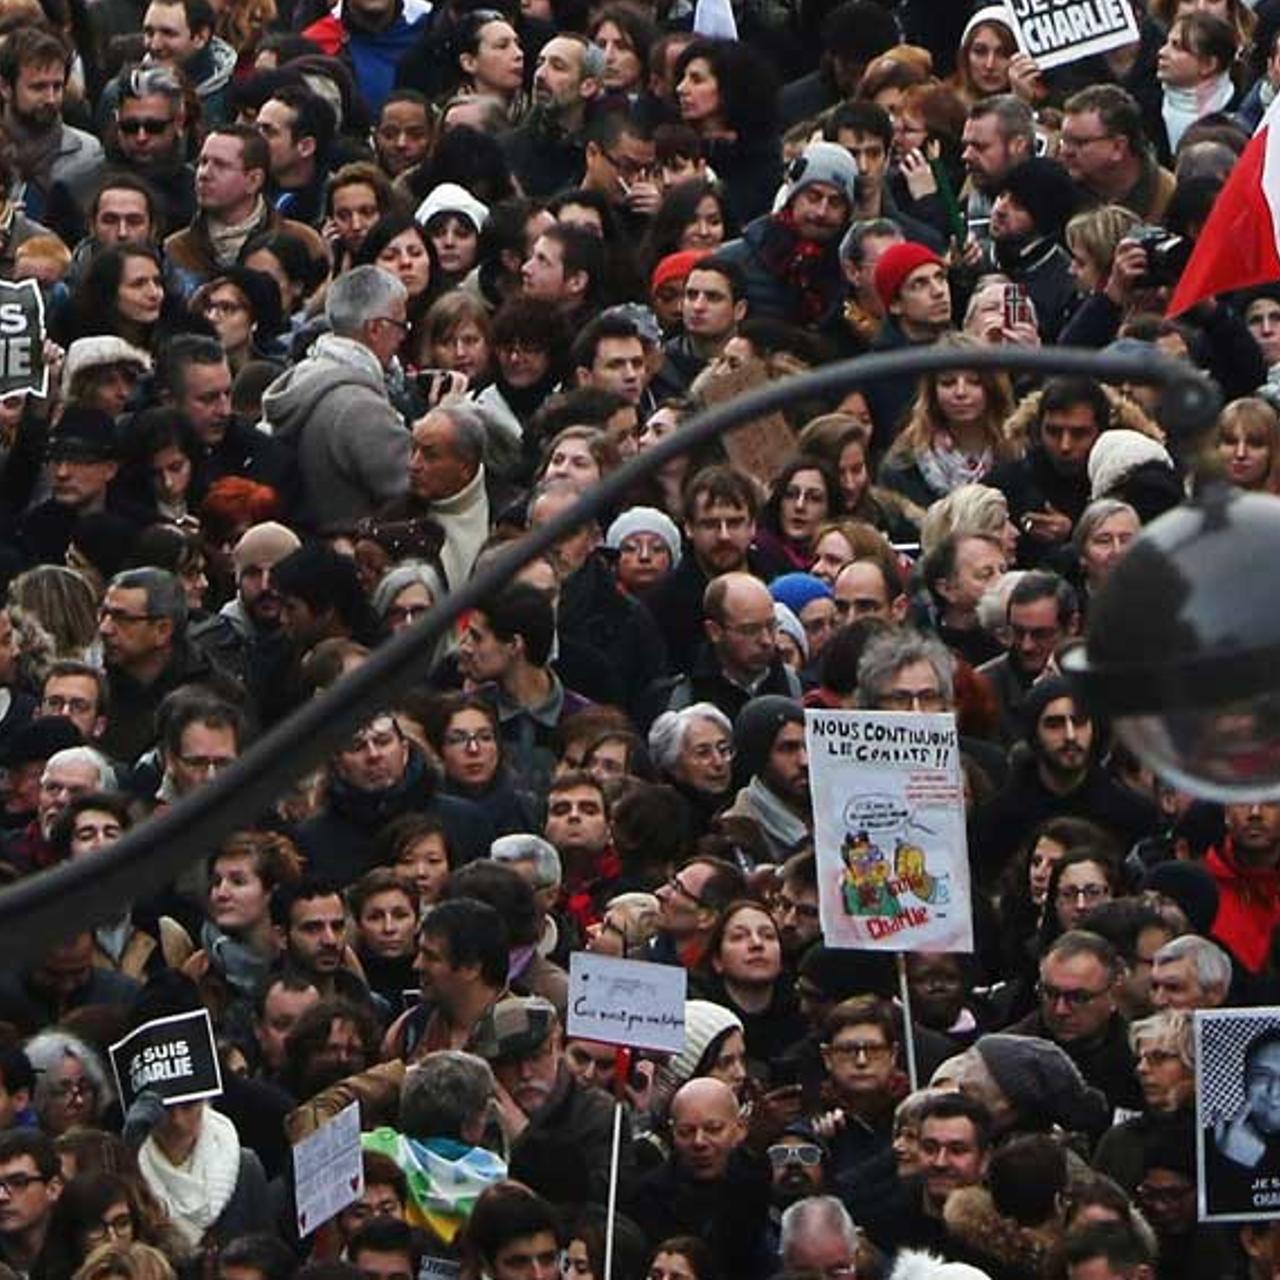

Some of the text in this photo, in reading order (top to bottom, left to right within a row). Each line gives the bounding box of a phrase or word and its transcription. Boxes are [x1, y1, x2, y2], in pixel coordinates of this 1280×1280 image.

[812, 718, 860, 740] NOUS
[143, 1039, 190, 1064] SUIS
[1251, 1178, 1269, 1190] JE
